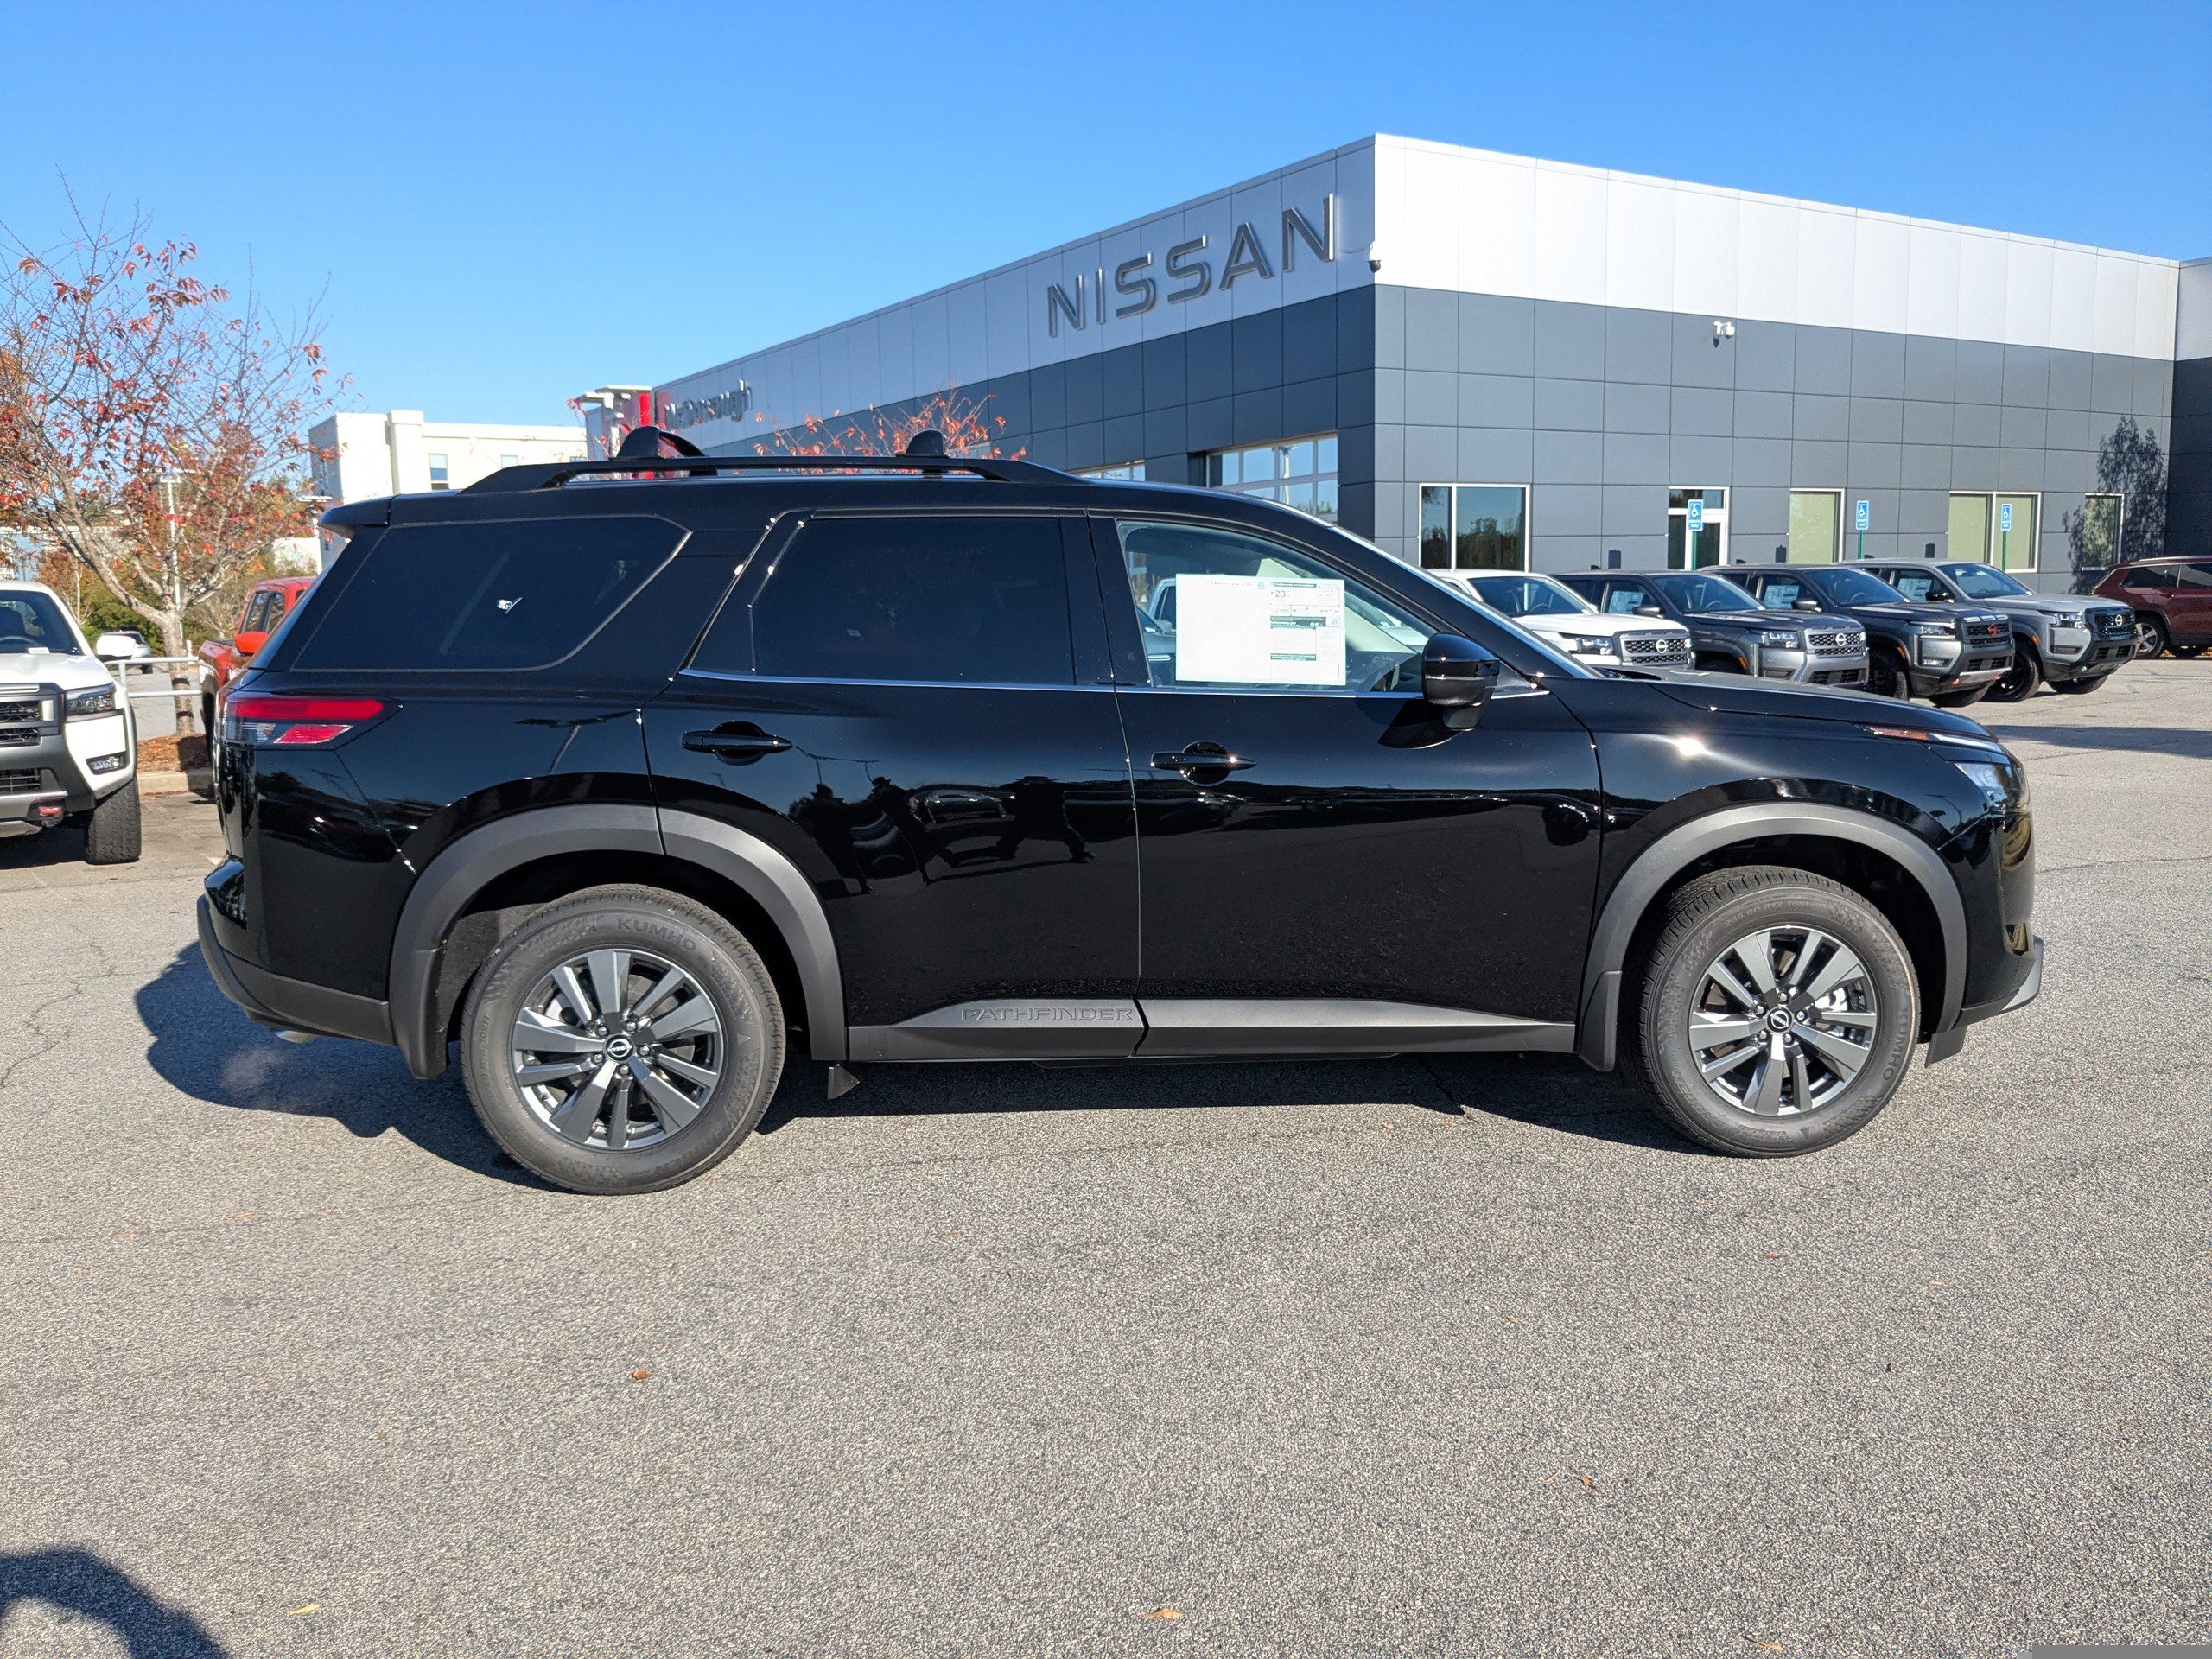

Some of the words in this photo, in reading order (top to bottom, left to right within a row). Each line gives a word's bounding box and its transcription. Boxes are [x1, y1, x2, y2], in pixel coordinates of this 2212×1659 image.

[1046, 193, 1336, 338] NISSAN
[617, 918, 697, 952] KUMHO
[960, 1007, 1134, 1022] PATHFINDER
[1882, 1007, 1909, 1081] KUMHO
